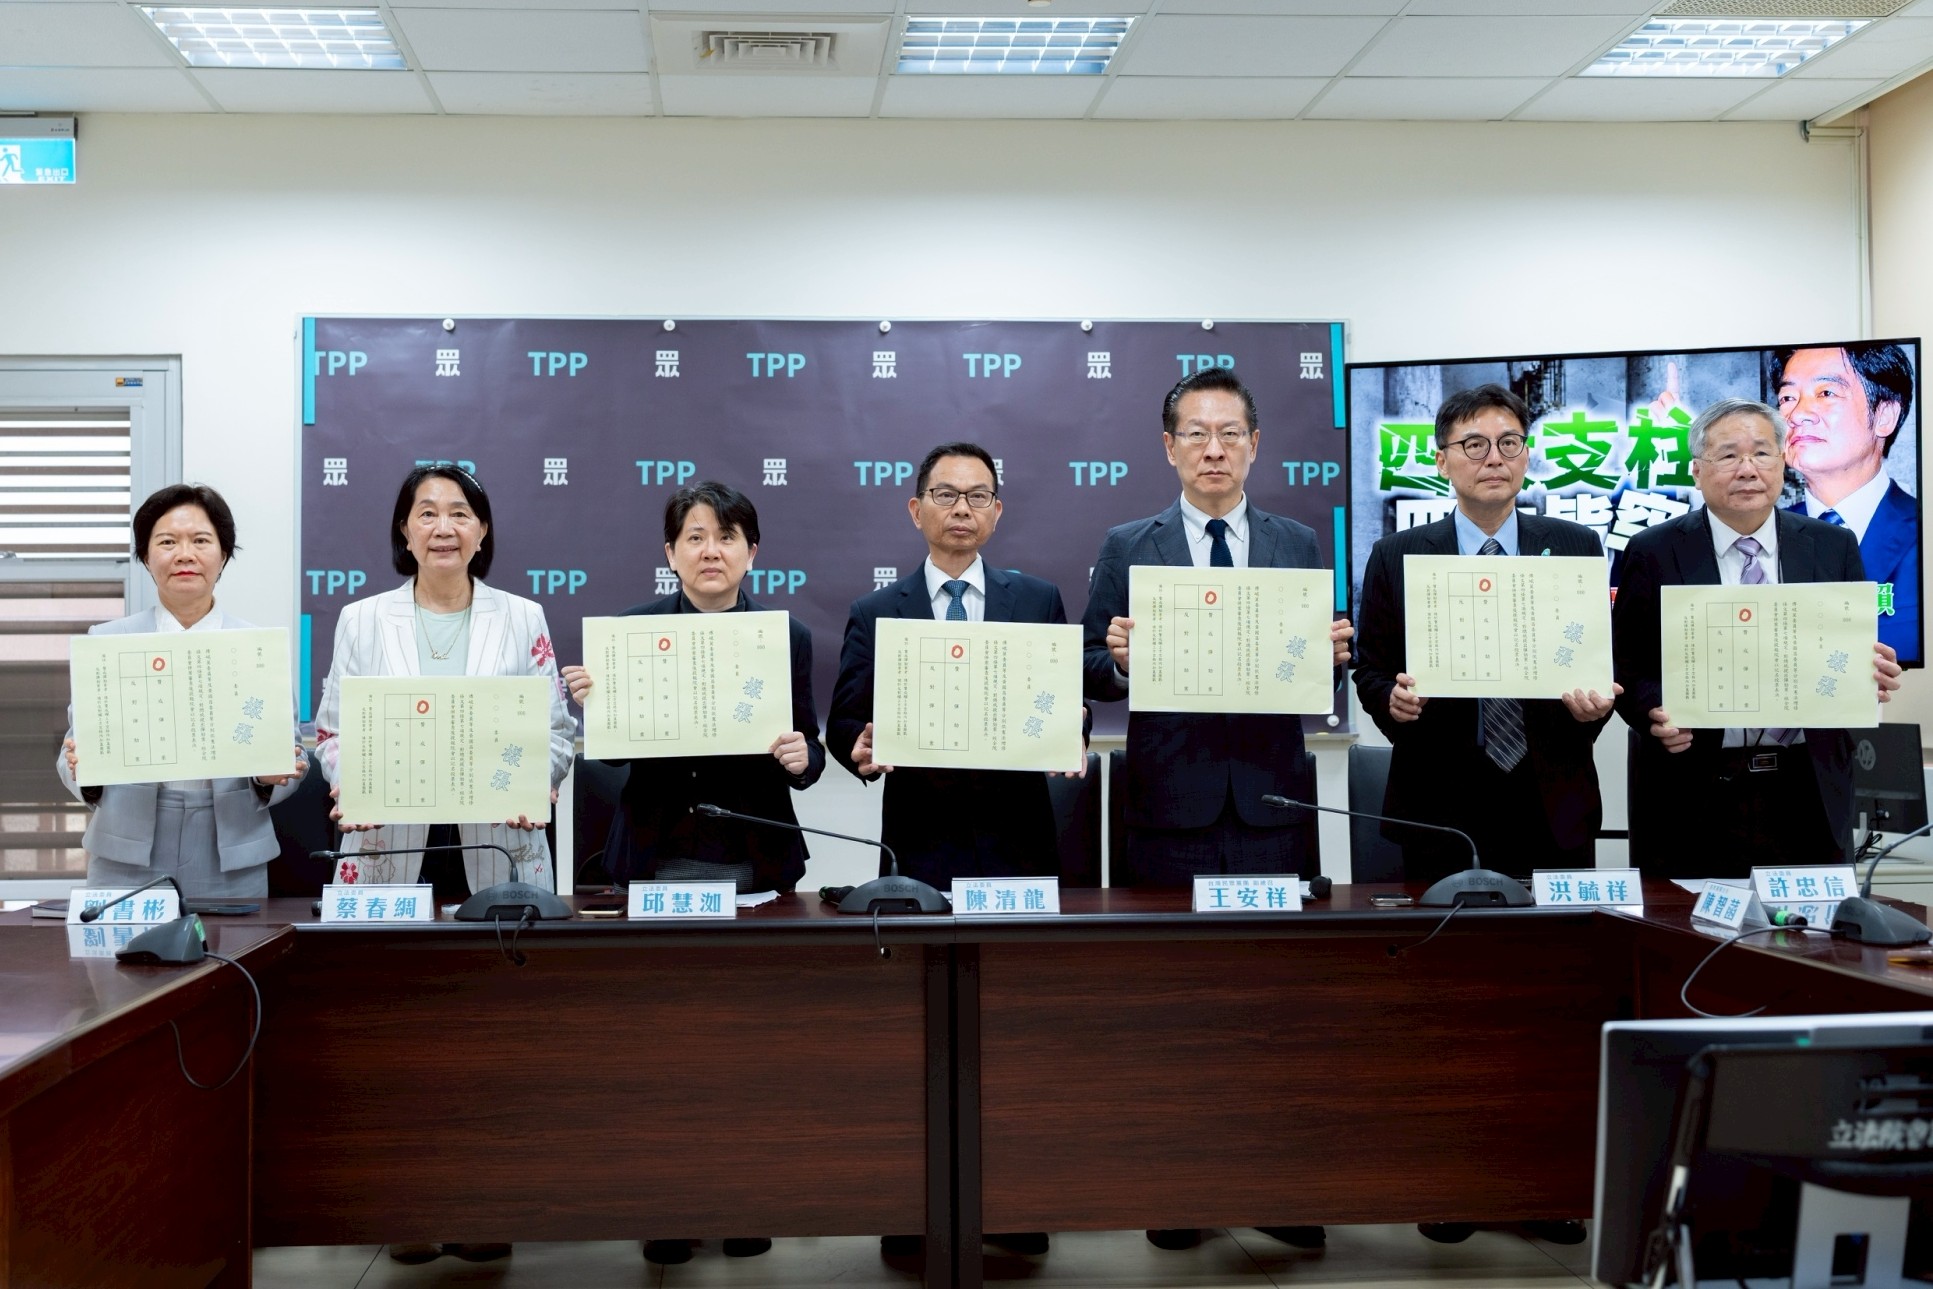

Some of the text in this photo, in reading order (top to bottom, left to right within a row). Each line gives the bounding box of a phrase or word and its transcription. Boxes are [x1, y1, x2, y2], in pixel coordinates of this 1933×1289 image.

[315, 351, 367, 376] TPP
[435, 349, 460, 376] 眾
[527, 351, 588, 376] TPP
[655, 350, 680, 377] 眾
[747, 353, 806, 378] TPP
[872, 351, 897, 379] 眾
[963, 353, 1022, 378] TPP
[1087, 351, 1112, 379] 眾
[1300, 352, 1324, 379] 眾
[1379, 407, 1695, 496] 四支柱
[323, 458, 348, 486] 眾
[543, 458, 568, 486] 眾
[636, 461, 696, 486] TPP
[763, 459, 788, 486] 眾
[854, 461, 913, 486] TPP
[1069, 461, 1128, 486] TPP
[1283, 461, 1340, 486] TPP
[306, 570, 367, 596] TPP
[527, 570, 587, 595] TPP
[748, 570, 807, 595] TPP
[884, 884, 919, 893] BOSCH
[1469, 877, 1504, 887] BOSCH
[1549, 880, 1628, 902] 洪毓祥
[1768, 876, 1845, 897] 許忠信
[336, 897, 416, 918] 蔡春綢
[503, 890, 539, 900] BOSCH
[643, 892, 721, 913] 邱慧洳
[966, 889, 1045, 911] 陳清龍
[1209, 887, 1287, 908] 王安祥
